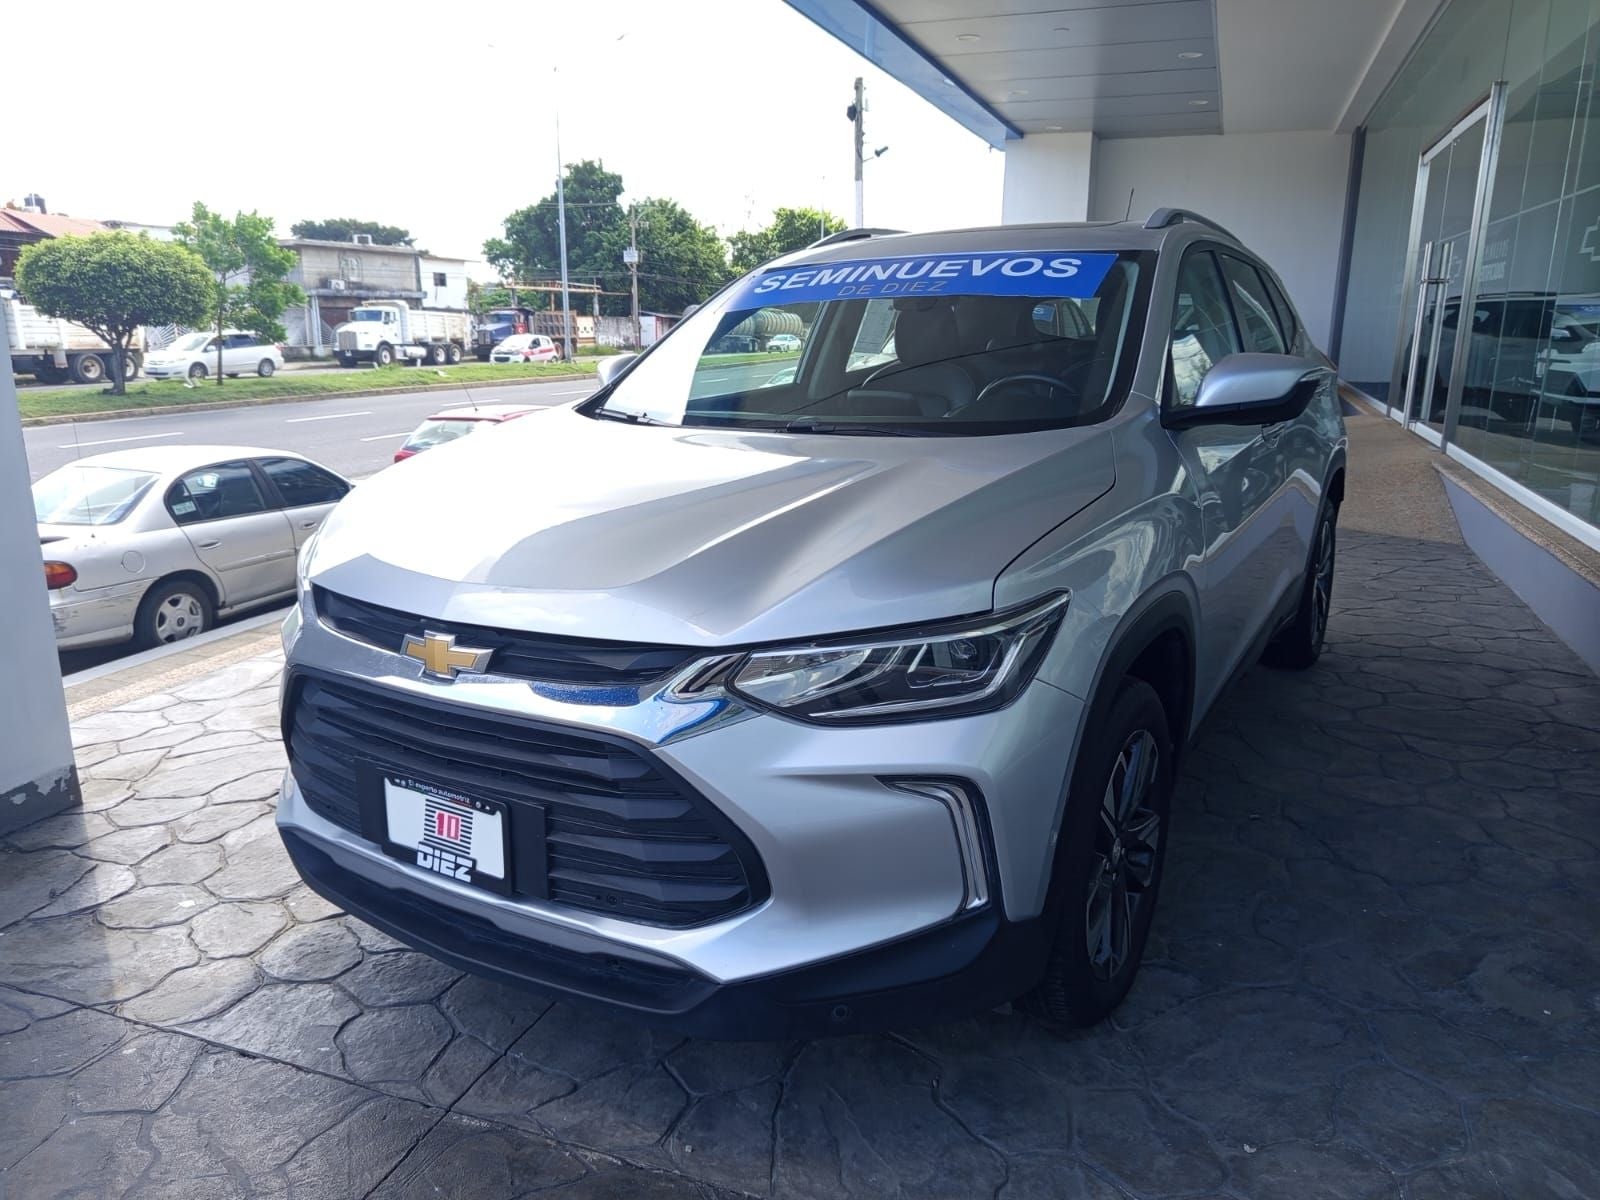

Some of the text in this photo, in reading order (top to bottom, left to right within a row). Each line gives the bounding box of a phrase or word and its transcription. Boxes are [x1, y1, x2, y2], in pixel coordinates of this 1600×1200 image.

[754, 257, 1082, 294] SEMINUEVOS
[837, 280, 948, 296] DE DIEZ
[436, 811, 461, 841] 10
[416, 842, 472, 883] DIEZ
